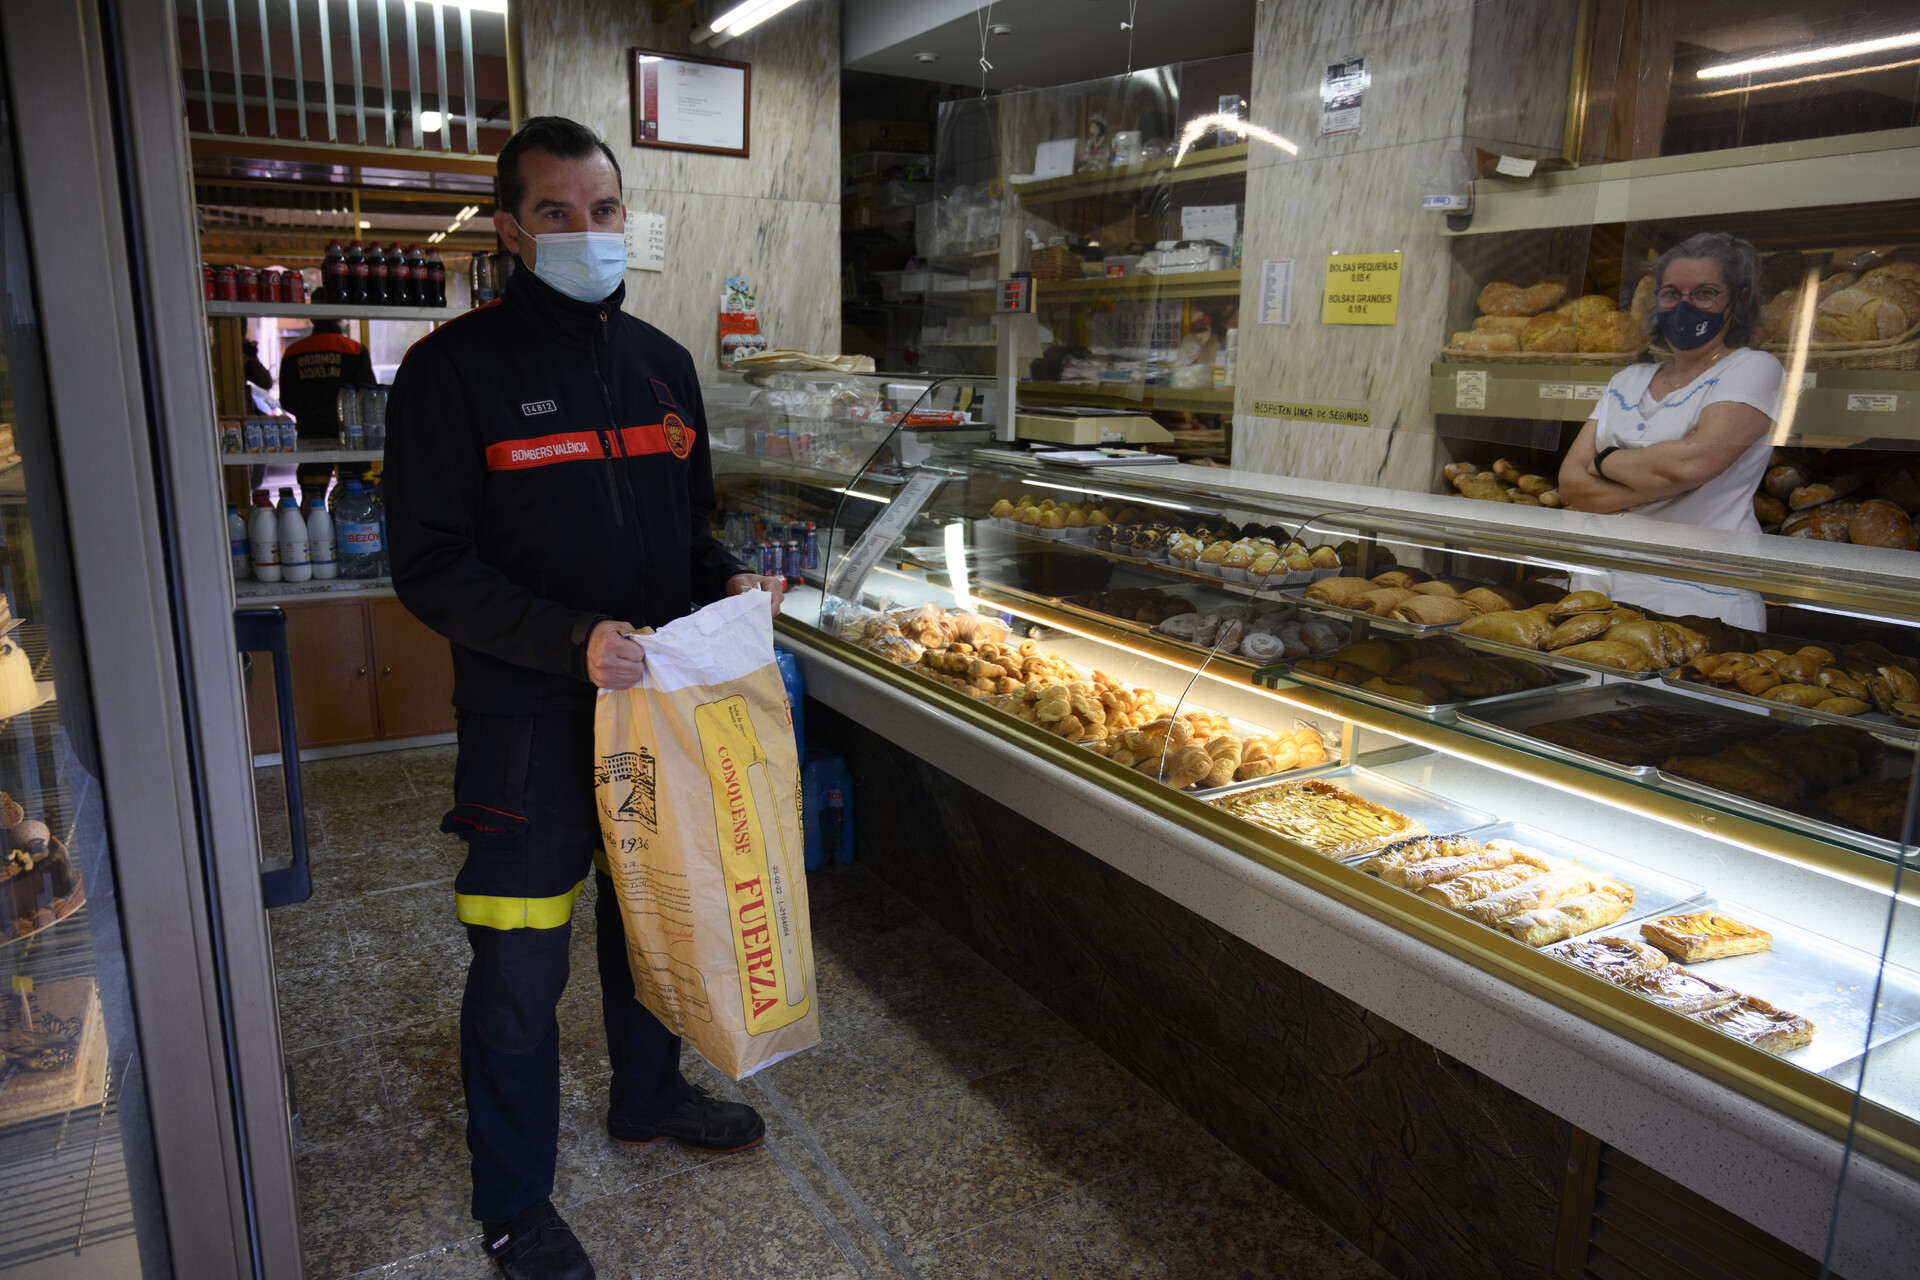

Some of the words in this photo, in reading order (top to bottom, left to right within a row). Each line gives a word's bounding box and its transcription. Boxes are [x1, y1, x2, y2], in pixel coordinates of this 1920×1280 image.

[1329, 263, 1356, 272] BOLSAS
[1357, 261, 1398, 272] PEQUEÑAS
[1351, 274, 1364, 283] 0,05
[1365, 273, 1371, 282] €
[1328, 294, 1355, 303] BOLSAS
[1356, 294, 1392, 303] GRANDES
[1348, 305, 1362, 314] 0,10
[1363, 305, 1368, 313] €
[526, 402, 553, 413] 14812
[1254, 402, 1291, 416] RESPETEN
[1293, 406, 1313, 418] LINEA
[1329, 410, 1369, 423] SEGURIDAD
[511, 446, 553, 462] BOMBERS
[553, 439, 589, 455] VALÈNCIA
[347, 532, 381, 543] BEZOY
[718, 746, 752, 856] CONQUENSE
[620, 837, 650, 854] 1936
[772, 866, 783, 895] 23-02-22
[734, 874, 779, 1021] FUERZA
